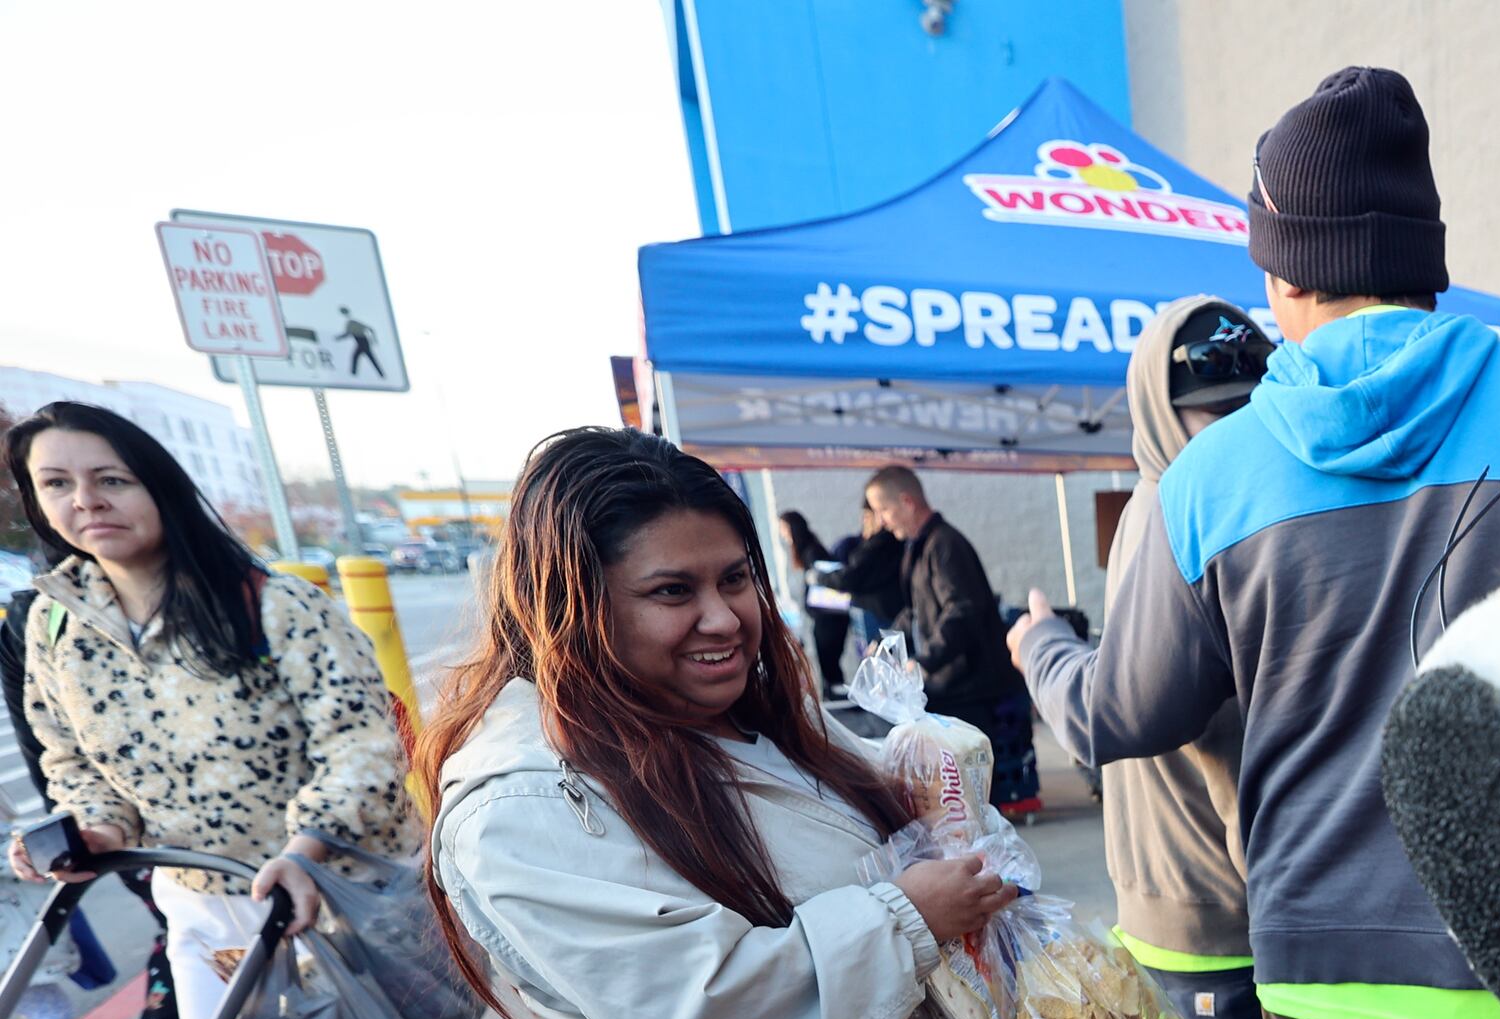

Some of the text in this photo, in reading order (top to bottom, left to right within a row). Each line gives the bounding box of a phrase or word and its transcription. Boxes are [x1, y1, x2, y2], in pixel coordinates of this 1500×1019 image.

[984, 188, 1250, 234] WONDER
[192, 240, 233, 267] NO
[270, 251, 322, 279] TOP
[174, 267, 267, 298] PARKING
[201, 297, 253, 320] FIRE
[203, 322, 264, 343] LANE
[942, 750, 967, 822] White
